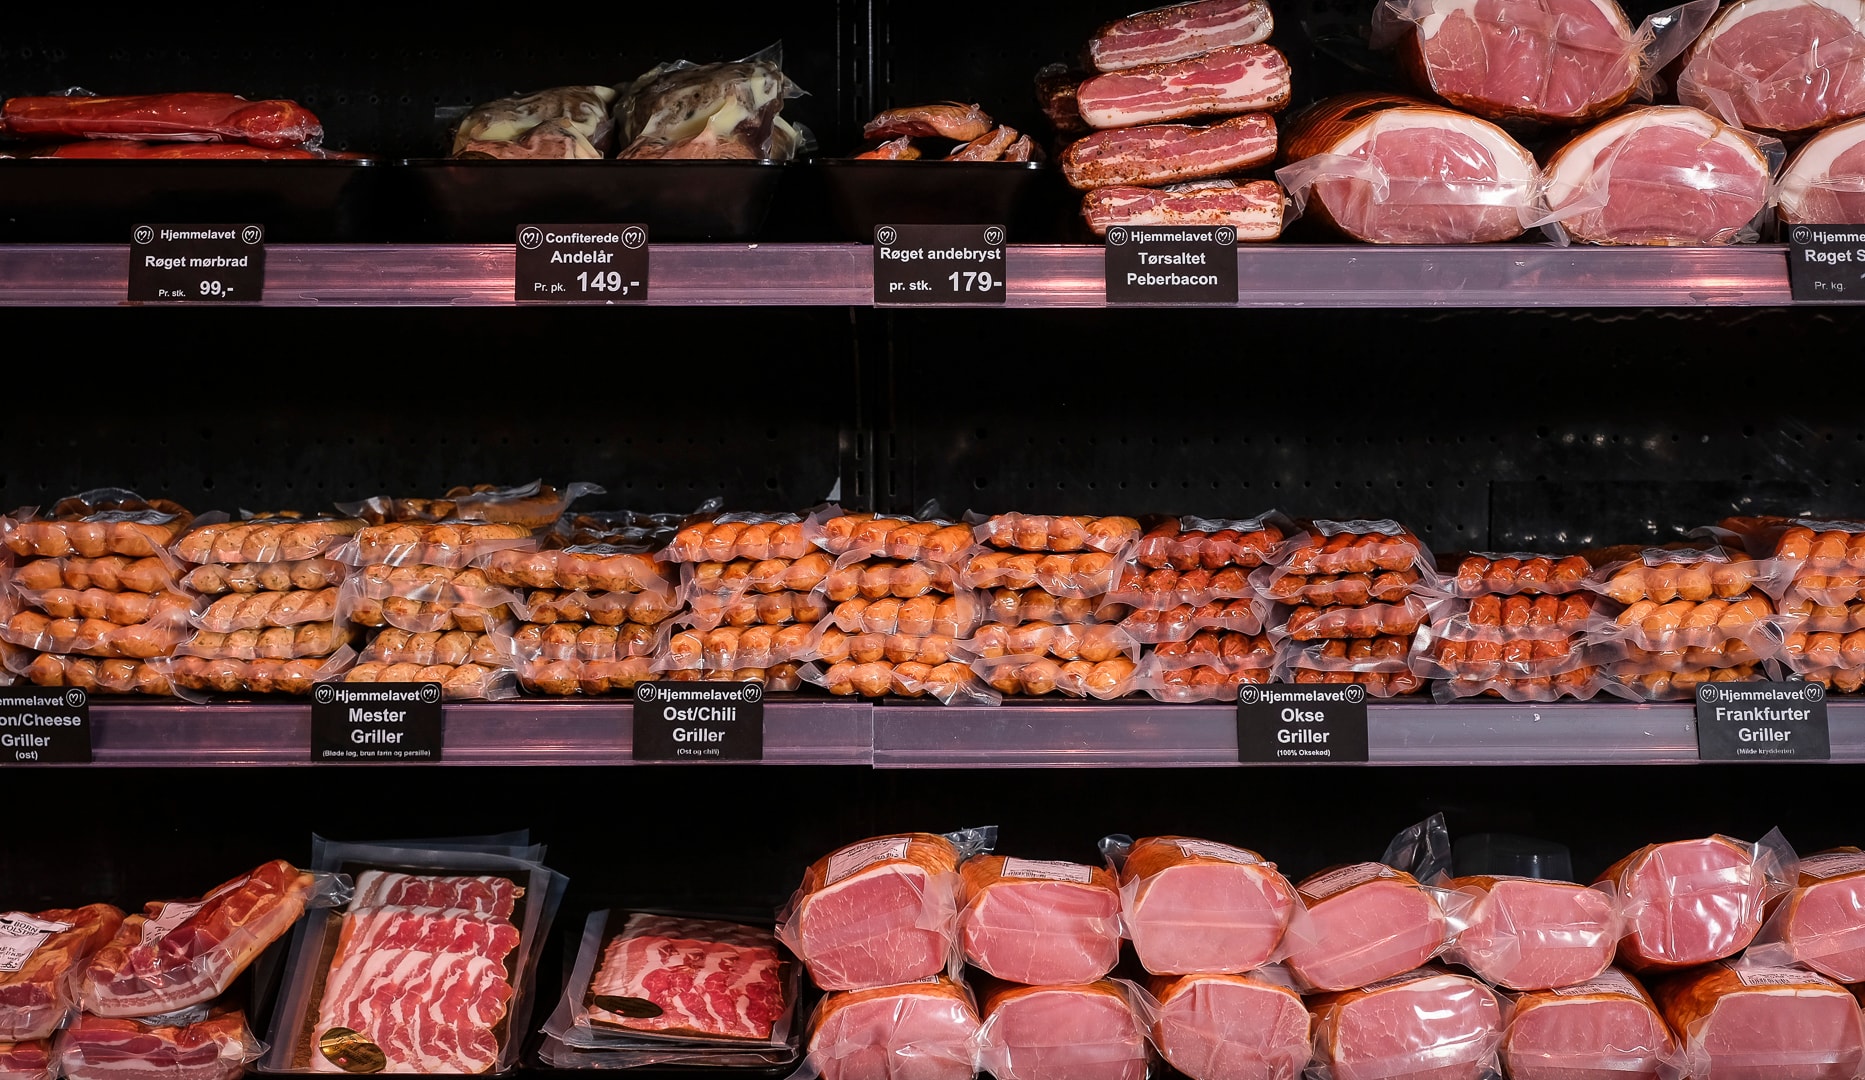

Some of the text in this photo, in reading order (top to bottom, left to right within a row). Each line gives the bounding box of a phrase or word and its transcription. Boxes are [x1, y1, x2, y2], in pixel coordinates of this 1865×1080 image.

[160, 230, 236, 242] Hjemmelavet
[546, 232, 620, 244] Confiterede
[1131, 231, 1212, 244] Hjemmelavet
[550, 250, 614, 264] Andelår
[880, 248, 1001, 262] Røget andebryst
[1138, 252, 1206, 264] Tørsaltet
[1804, 249, 1852, 265] Røget
[145, 256, 248, 270] Røget mørbrad
[534, 271, 640, 296] Pr. pk. 149,-
[889, 271, 1002, 292] pr. stk. 179-
[1127, 272, 1218, 286] Peberbacon
[200, 280, 234, 298] 99,-
[1814, 282, 1846, 292] Pr. kg.
[335, 690, 420, 704] Hjemmelavet
[658, 688, 742, 702] Hjemmelavet
[1260, 690, 1344, 704] Hjemmelavet
[1720, 689, 1804, 702] Hjemmelavet
[348, 708, 406, 722] Mester
[663, 706, 736, 721] Ost/Chili
[1281, 708, 1324, 722] Okse
[1716, 707, 1810, 721] Frankfurter
[1, 734, 50, 746] Griller
[351, 729, 404, 744] Griller
[672, 728, 726, 742] Griller
[1277, 729, 1330, 743] Griller
[1738, 728, 1791, 742] Griller
[16, 750, 38, 760] (ost)
[404, 749, 430, 758] persille)
